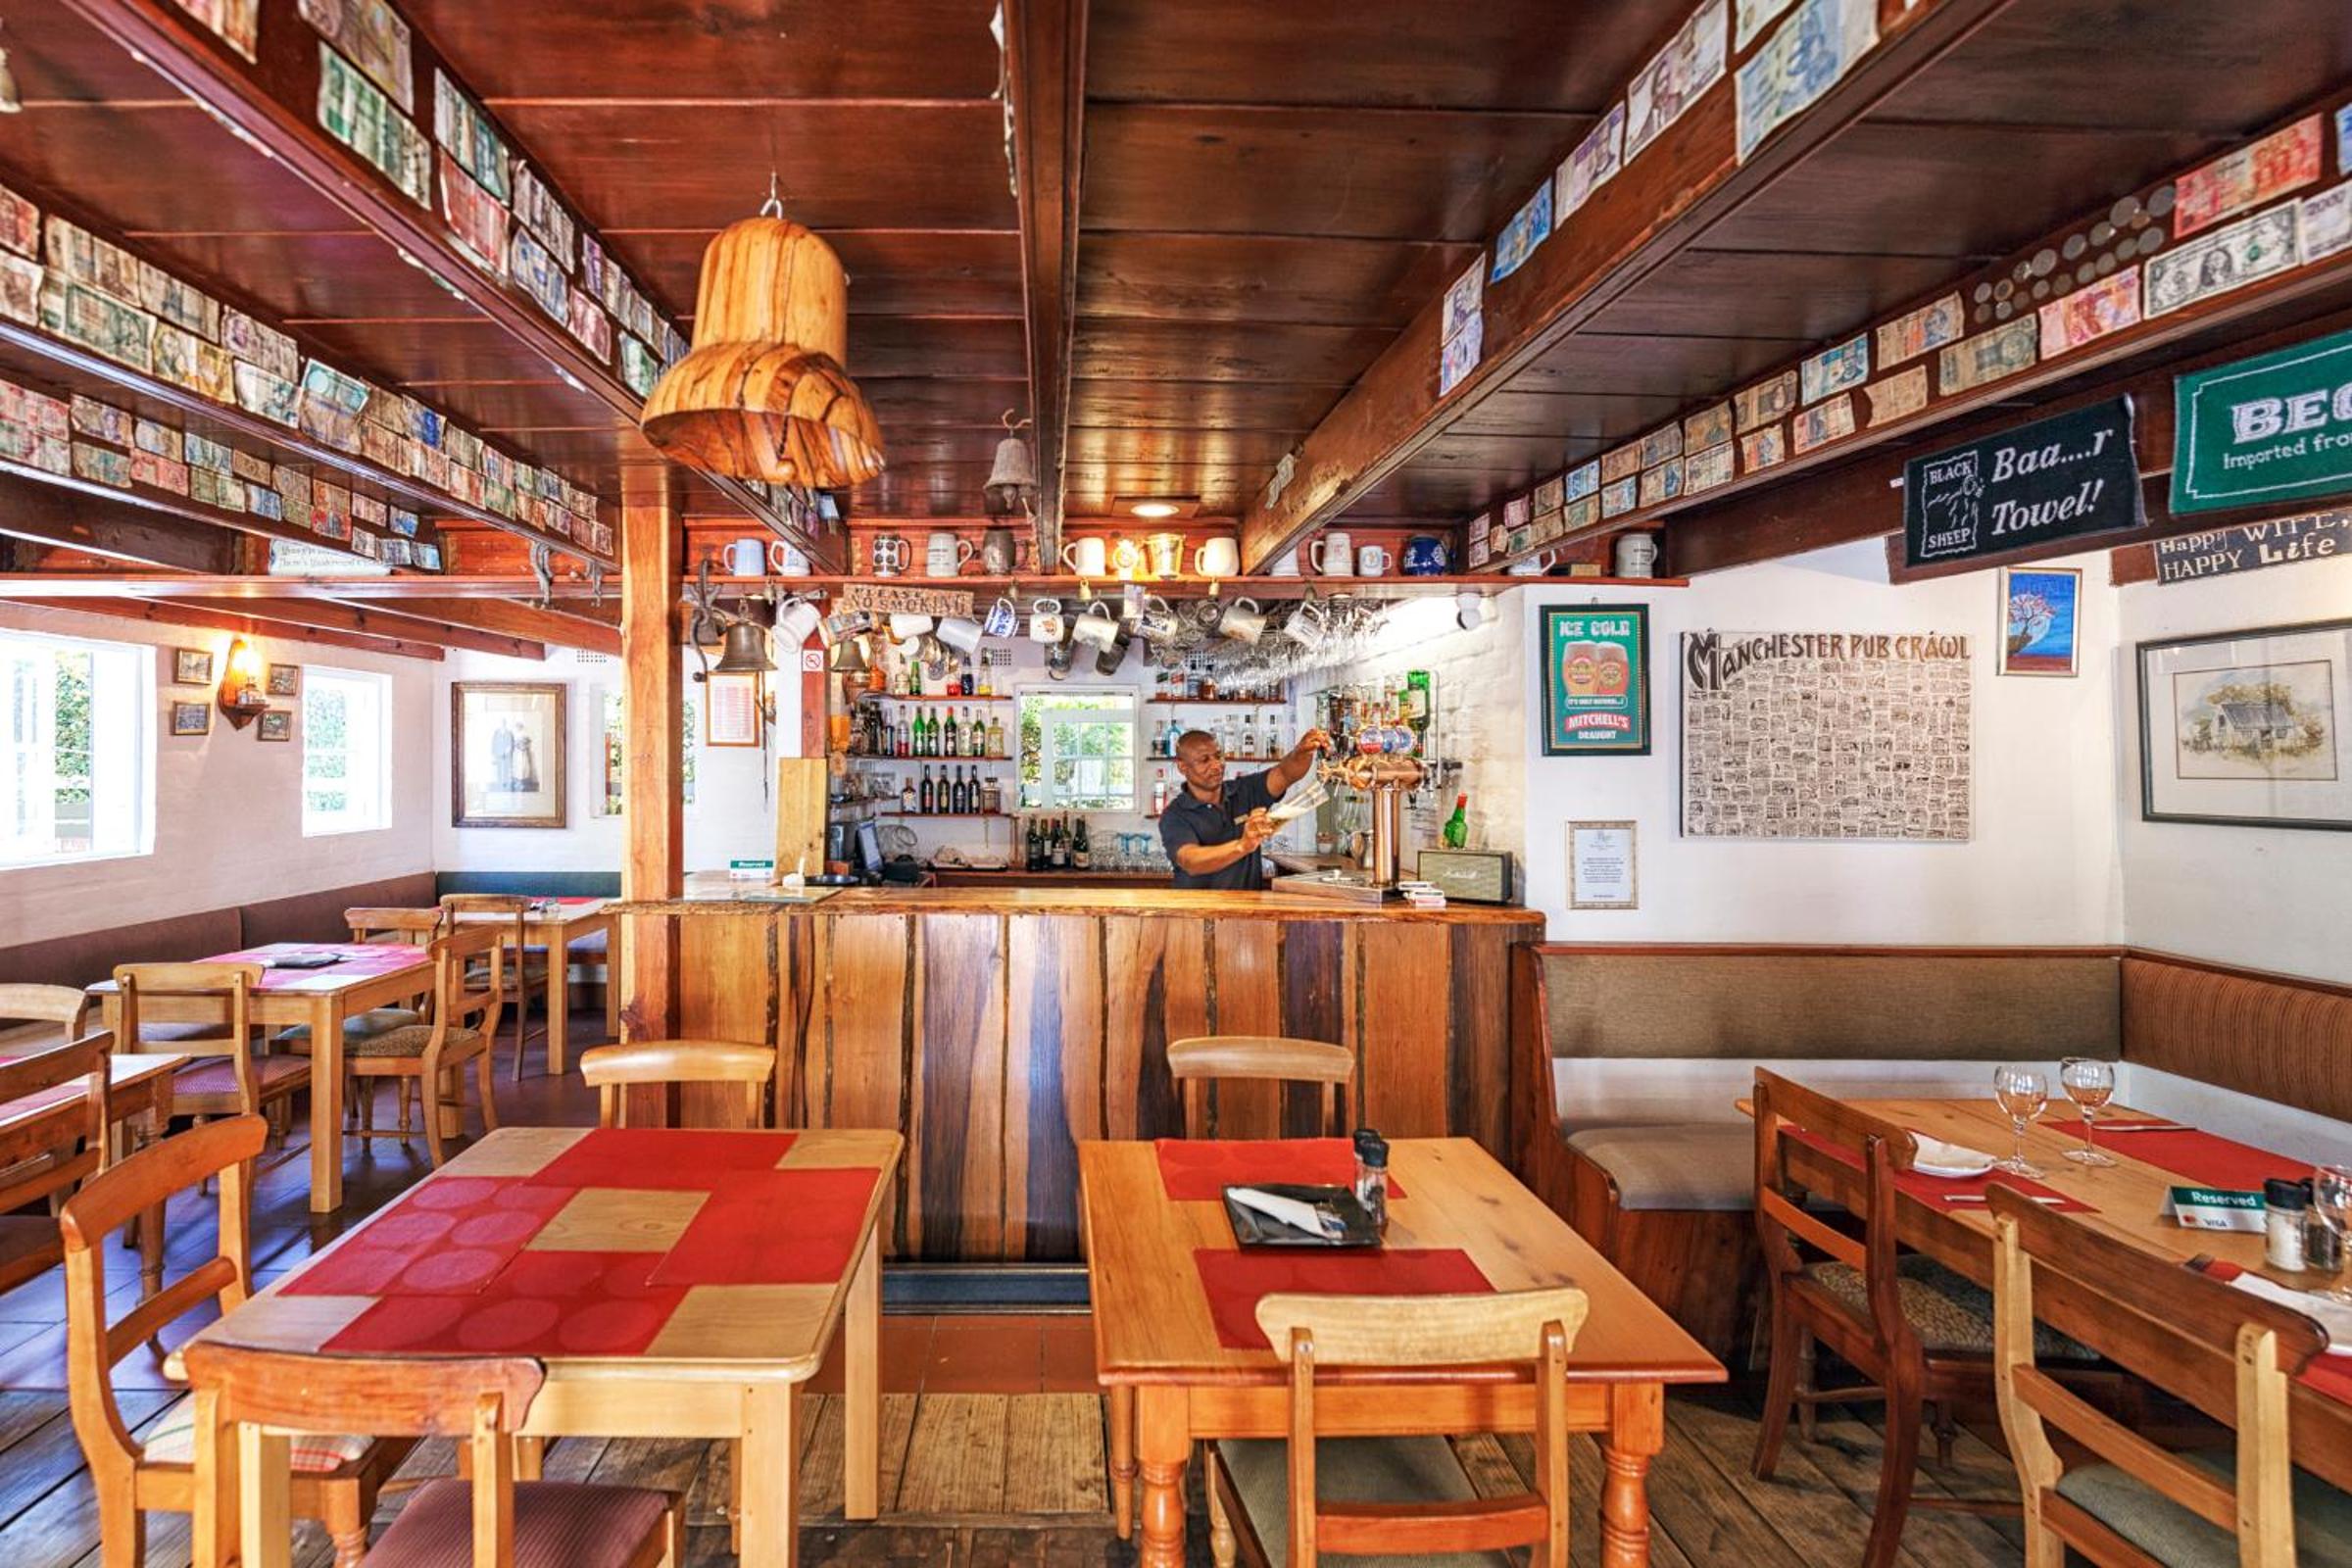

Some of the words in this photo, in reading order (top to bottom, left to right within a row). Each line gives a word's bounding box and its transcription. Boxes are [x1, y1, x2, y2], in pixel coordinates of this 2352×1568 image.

[2224, 437, 2306, 469] Imported
[2314, 433, 2352, 451] fro
[1930, 460, 1973, 484] BLACK
[1991, 478, 2103, 535] Towel!
[1928, 529, 1970, 549] SHEEP
[2164, 550, 2242, 580] HAPPY
[2259, 532, 2335, 564] Life
[880, 594, 966, 615] SMOKING
[1560, 621, 1584, 636] ICE
[1591, 621, 1630, 636] COLD
[1688, 633, 1845, 690] MANCHESTER
[1849, 634, 1890, 659] PUB
[1568, 713, 1629, 729] MITCHELL'S
[2191, 1191, 2257, 1207] Reserved
